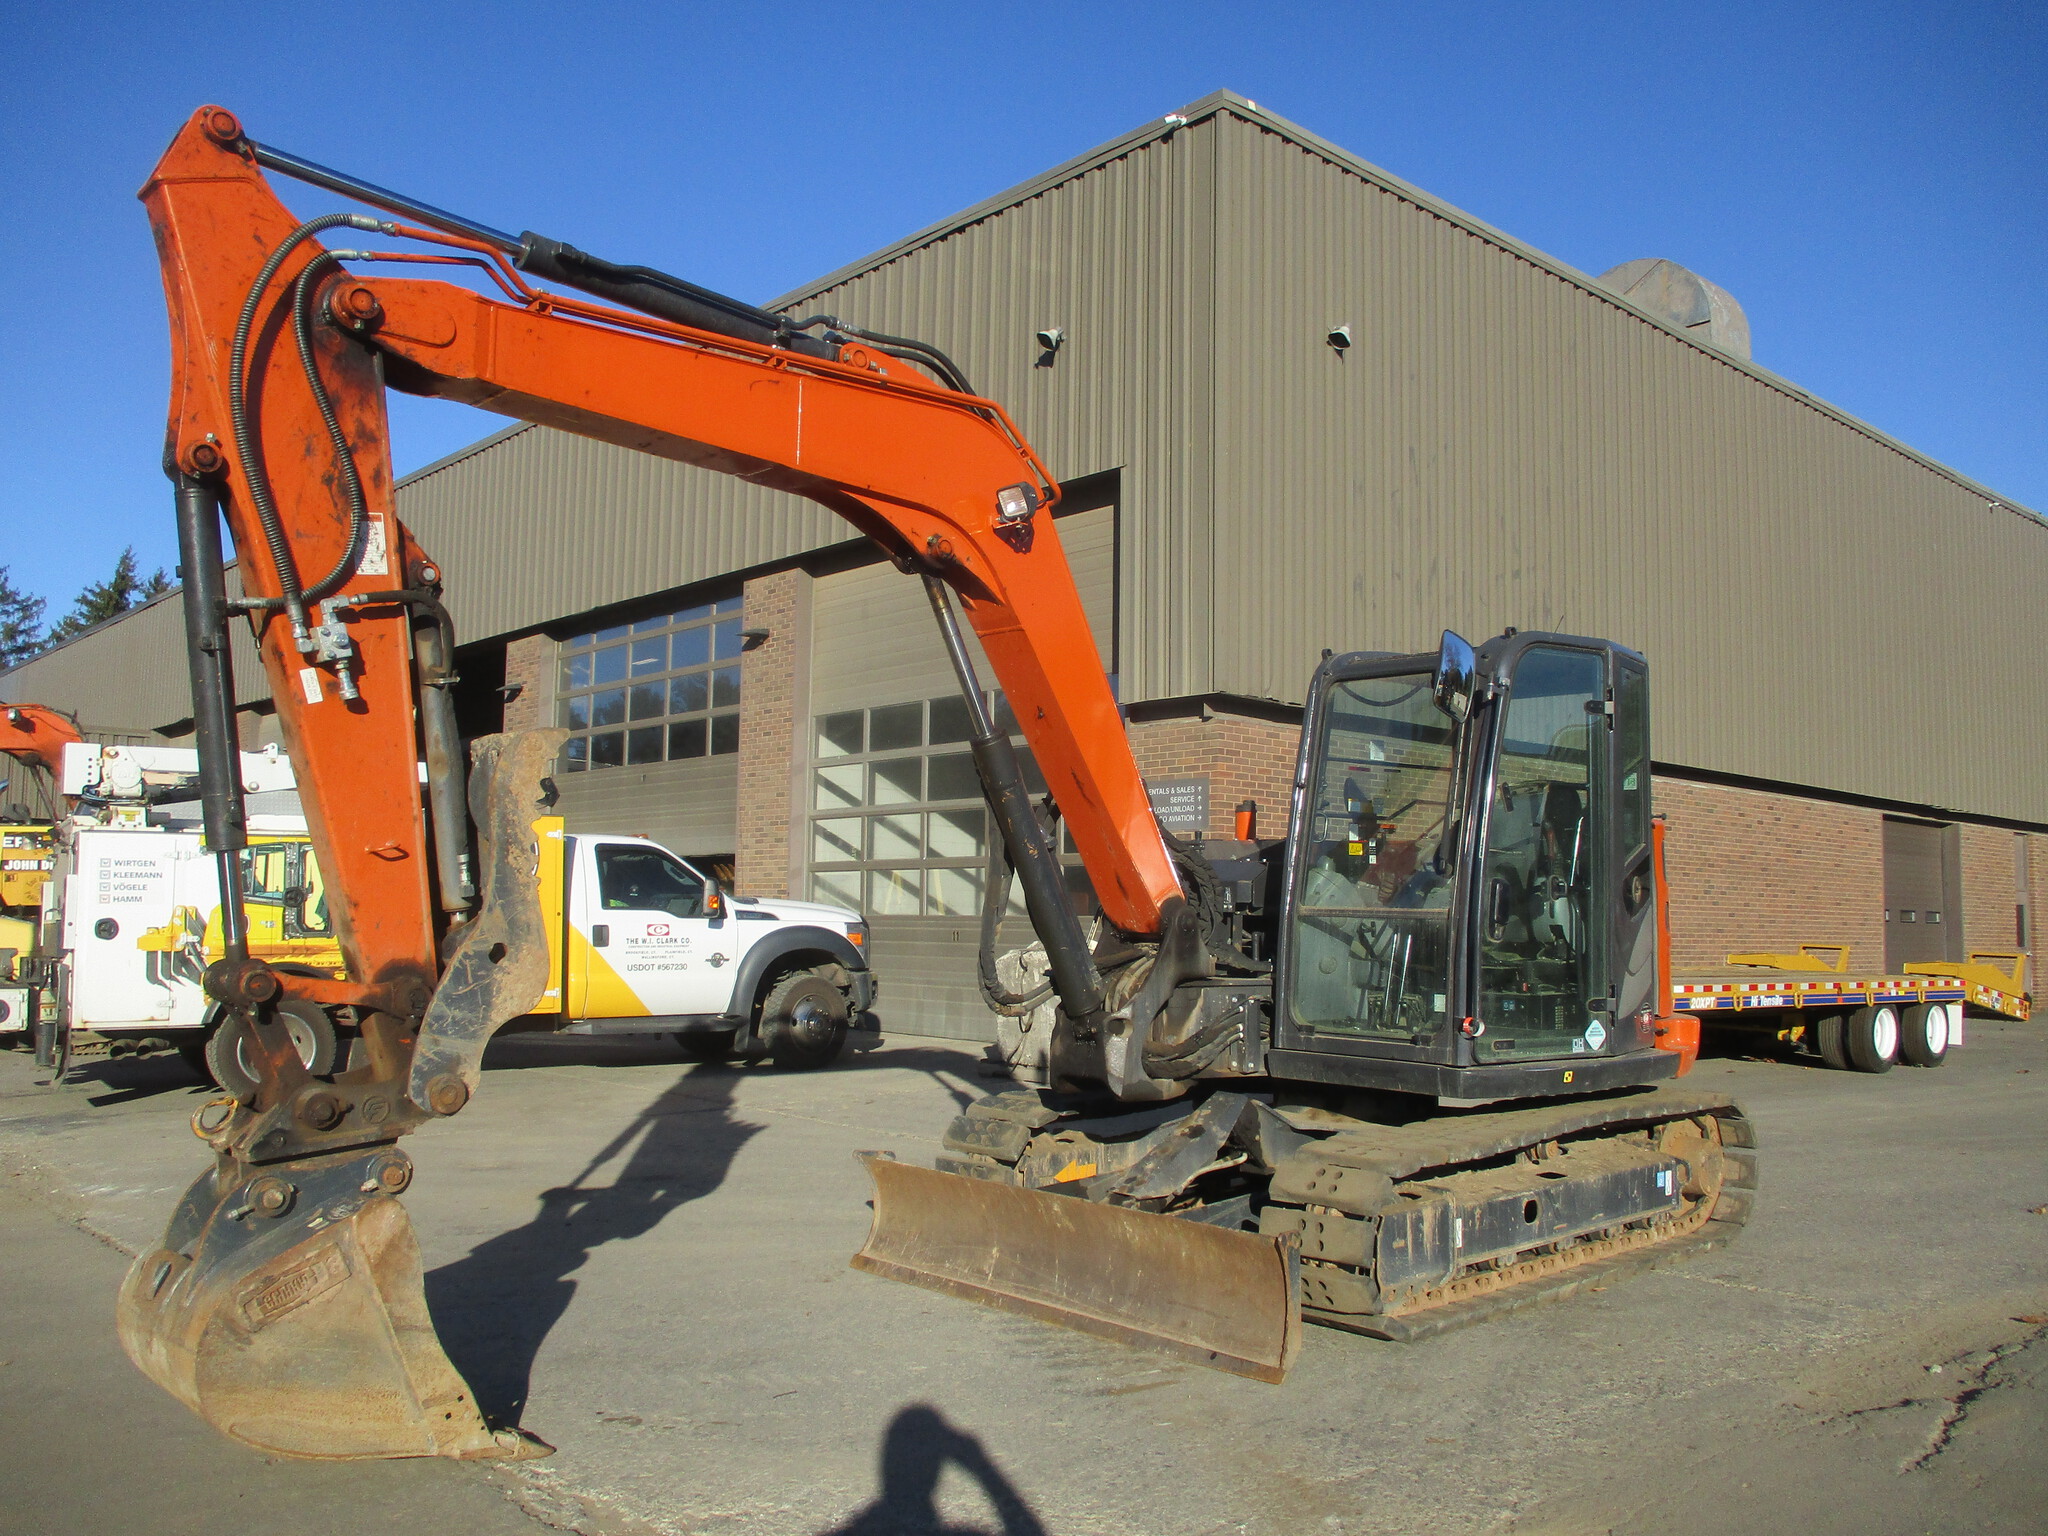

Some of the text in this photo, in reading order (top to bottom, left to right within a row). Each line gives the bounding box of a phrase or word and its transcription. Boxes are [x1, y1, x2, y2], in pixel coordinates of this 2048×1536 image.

[4, 860, 38, 870] JOHN
[627, 963, 688, 972] USDOT #567230
[1690, 997, 1715, 1009] 20XPT
[1751, 995, 1784, 1007] Hi Tensile
